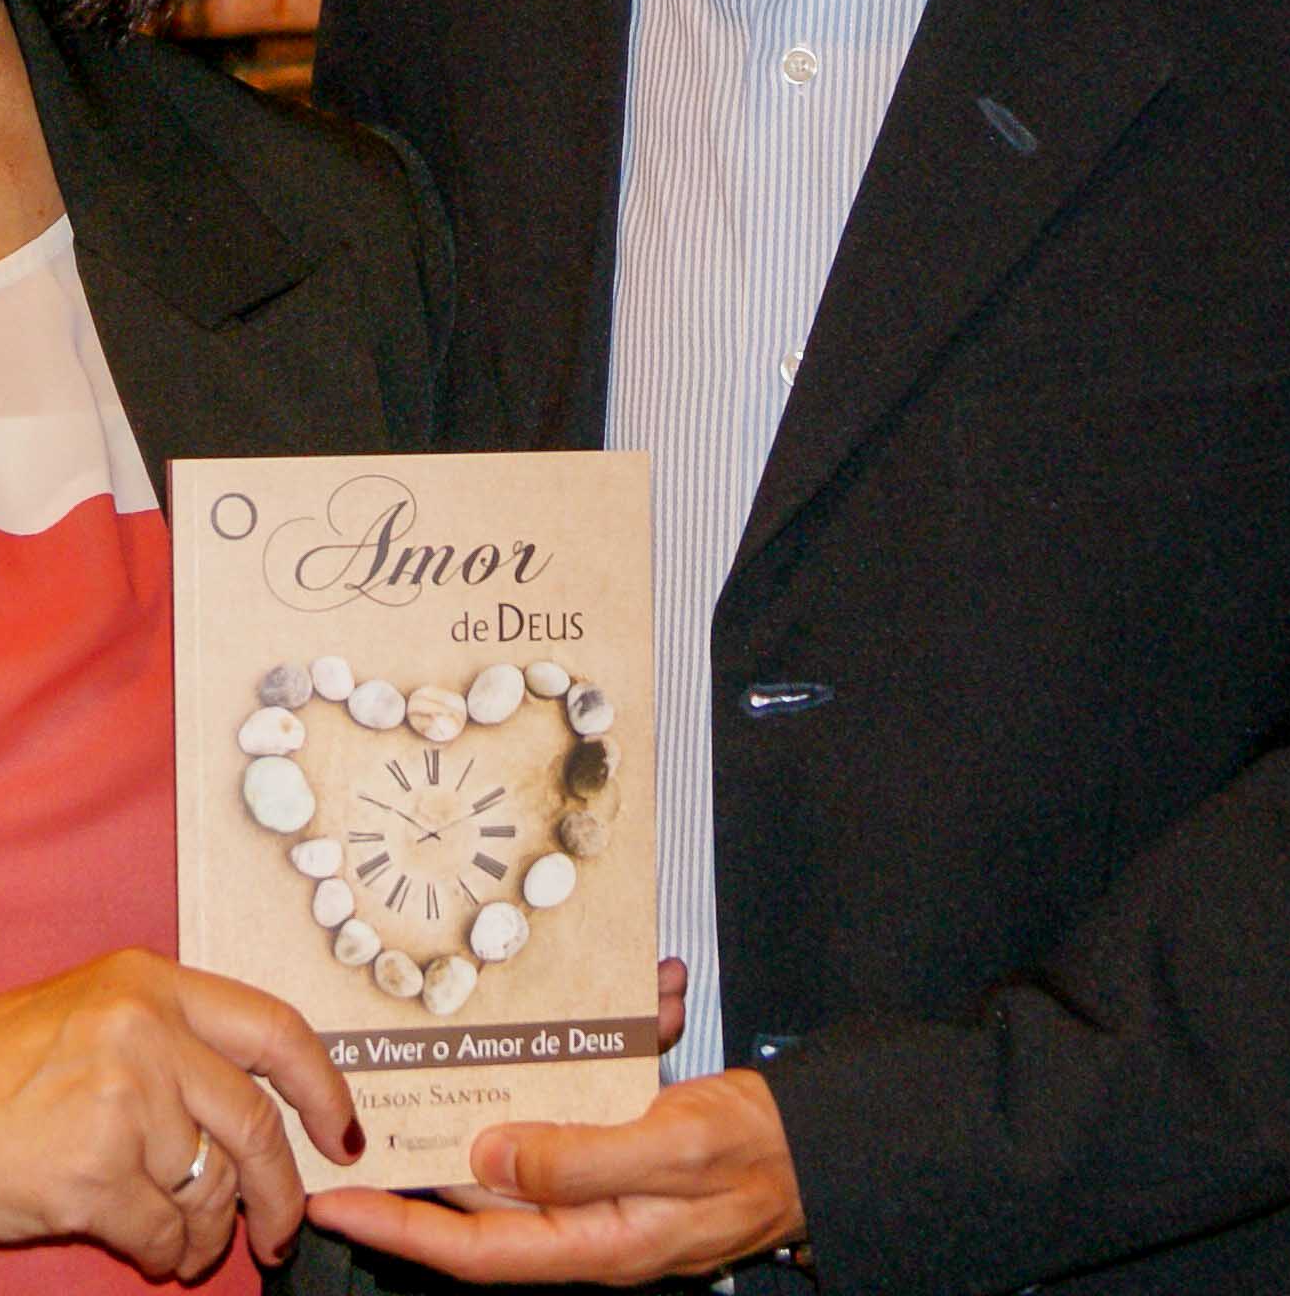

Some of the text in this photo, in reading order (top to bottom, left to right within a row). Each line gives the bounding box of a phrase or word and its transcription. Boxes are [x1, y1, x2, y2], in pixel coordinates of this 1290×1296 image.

[211, 474, 554, 613] O Amor
[450, 604, 585, 643] de DEUS
[330, 1027, 625, 1065] de Viver o Amor de Deus
[355, 1087, 422, 1109] ILSON
